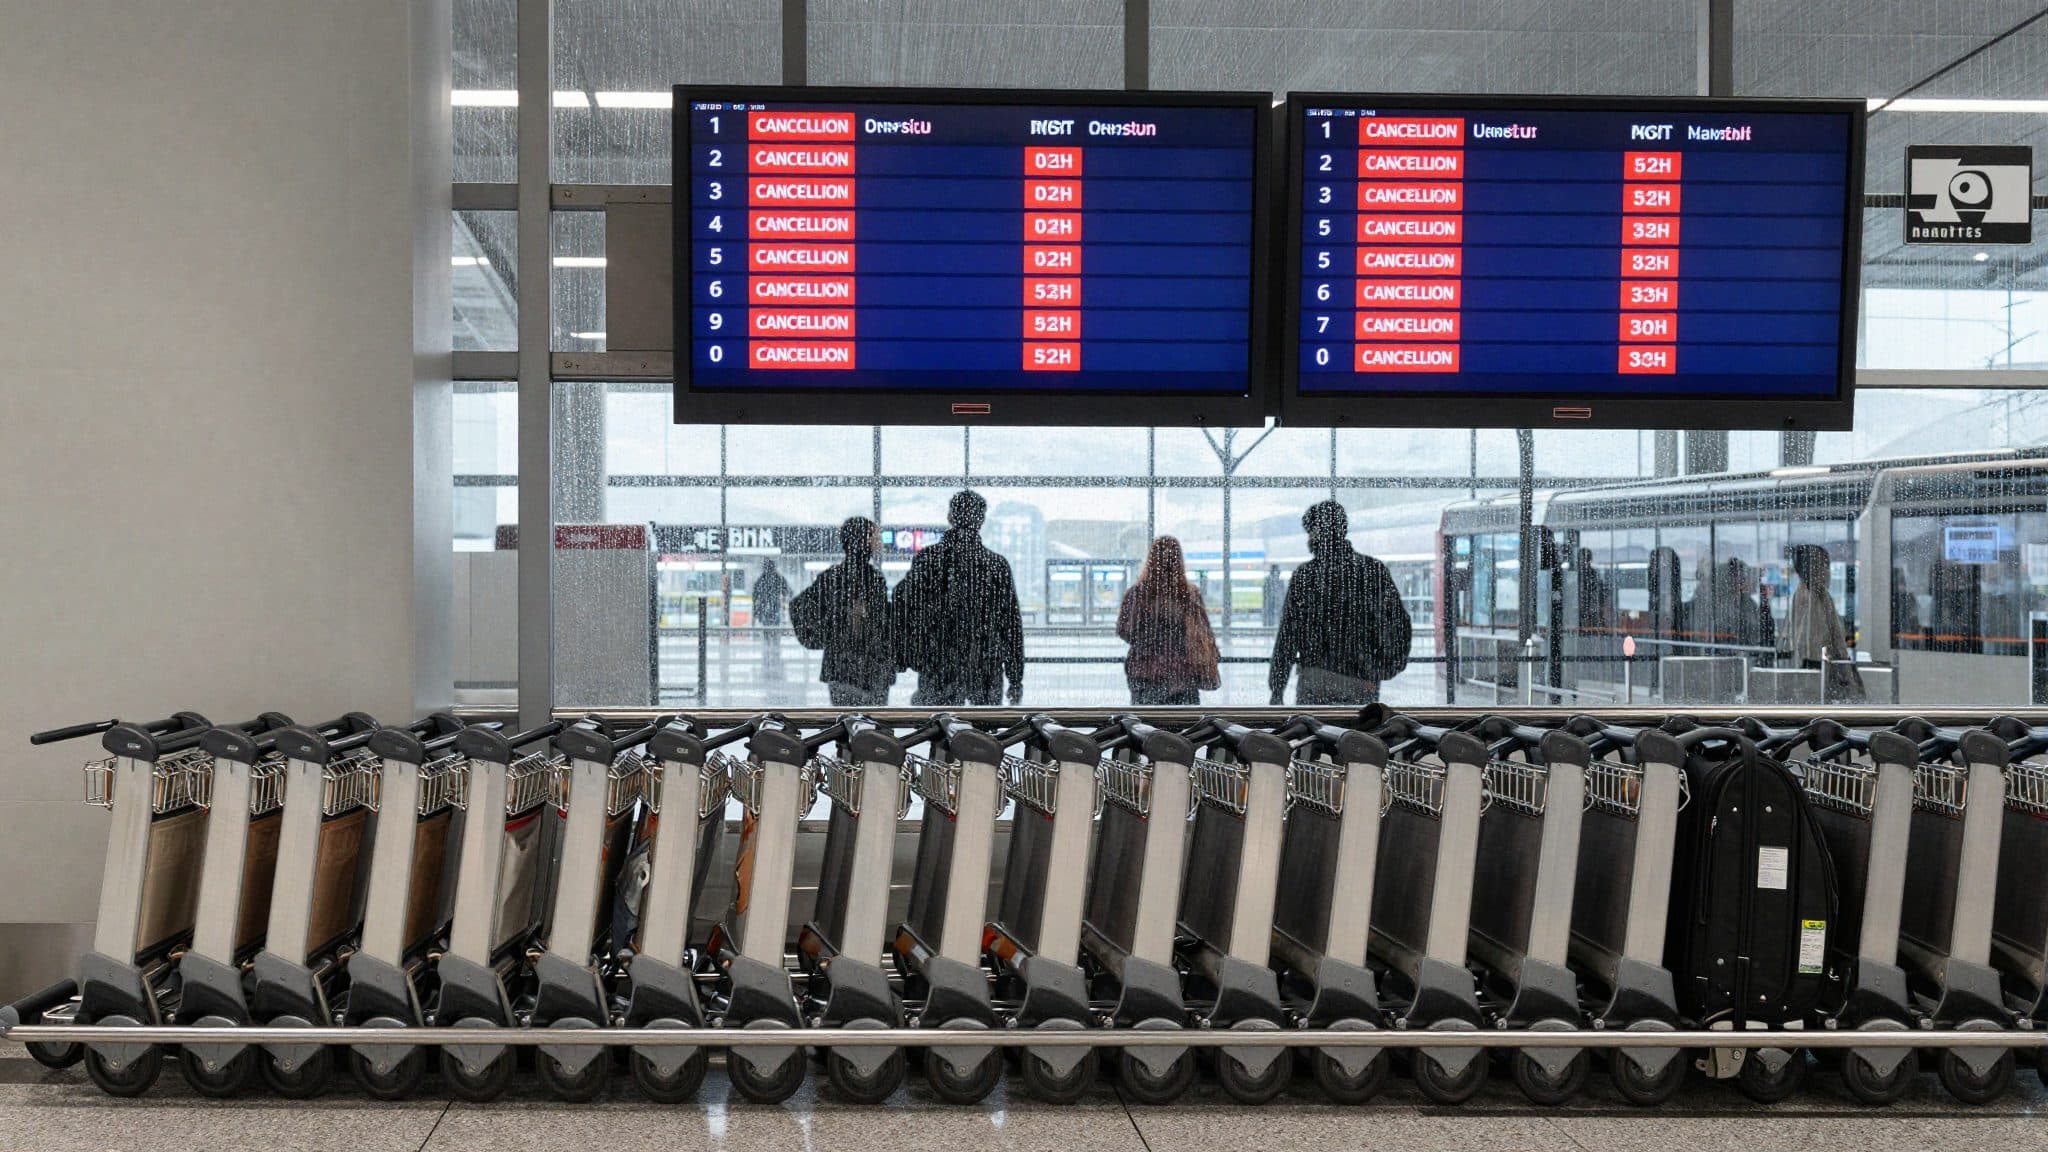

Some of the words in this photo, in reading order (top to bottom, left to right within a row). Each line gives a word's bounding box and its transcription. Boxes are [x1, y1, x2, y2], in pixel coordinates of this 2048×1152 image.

[709, 116, 719, 134] 1
[1321, 122, 1330, 139] 1
[1366, 123, 1458, 139] CANCELLION
[709, 149, 723, 167] 2
[755, 151, 849, 167] CANCELLION
[1319, 154, 1332, 171] 2
[1365, 156, 1457, 171] CANCELLION
[1634, 157, 1672, 173] 52H
[709, 182, 723, 200] 3
[755, 184, 849, 200] CANCELLION
[1034, 185, 1073, 202] 02H
[1318, 187, 1332, 204] 3
[1364, 188, 1457, 203] CANCELLION
[1633, 189, 1671, 206] 52H
[708, 215, 723, 233] 4
[755, 217, 849, 233] CANCELLION
[1034, 218, 1073, 235] 02H
[1318, 219, 1331, 236] 5
[1364, 221, 1456, 236] CANCELLION
[709, 247, 723, 265] 5
[755, 249, 849, 265] CANCELLION
[1034, 251, 1073, 267] 02H
[1318, 252, 1331, 268] 5
[1363, 253, 1456, 268] CANCELLION
[709, 280, 723, 298] 6
[755, 282, 849, 298] CANCELLION
[1317, 284, 1330, 301] 6
[1363, 286, 1455, 300] CANCELLION
[709, 312, 723, 330] 9
[755, 315, 849, 330] CANCELLION
[1316, 316, 1330, 333] 7
[1362, 318, 1454, 333] CANCELLION
[709, 345, 723, 363] 0
[755, 347, 849, 363] CANCELLION
[1033, 348, 1072, 365] 52H
[1316, 348, 1329, 365] 0
[1361, 350, 1453, 365] CANCELLION
